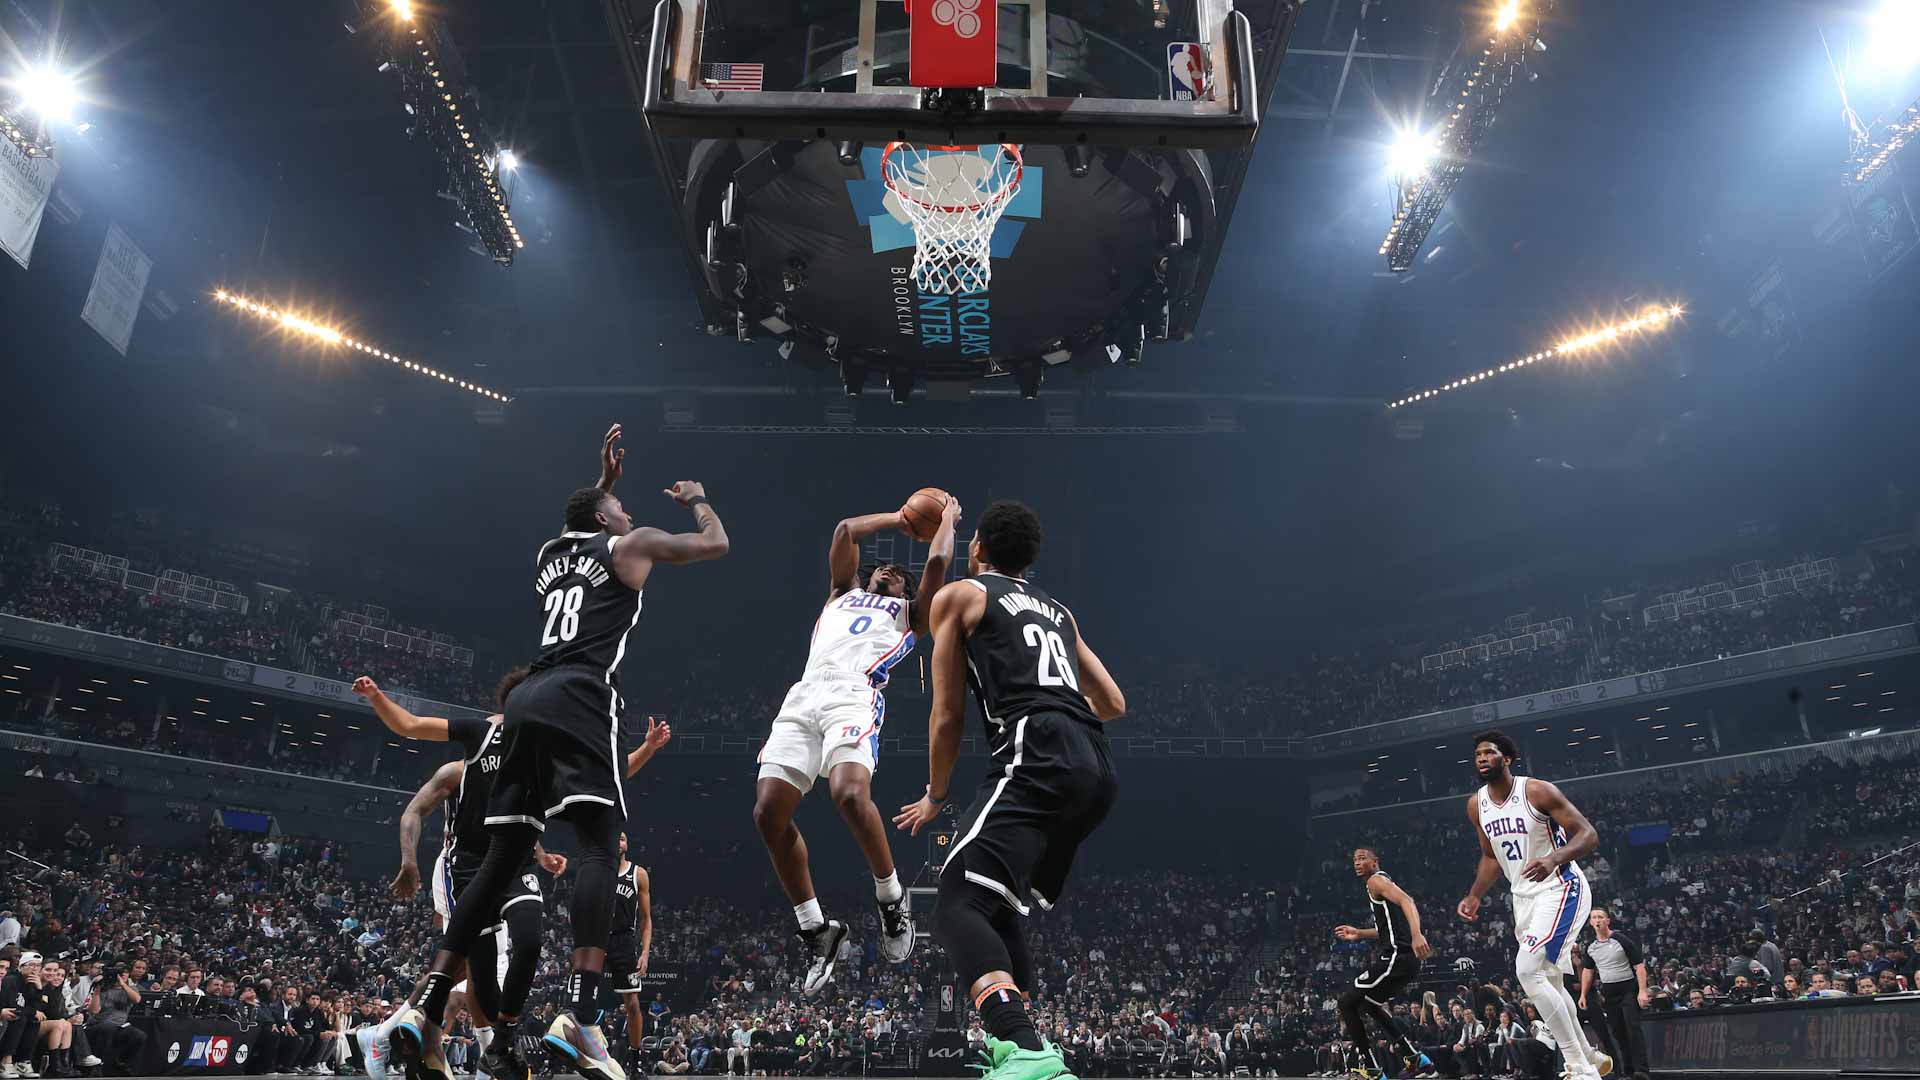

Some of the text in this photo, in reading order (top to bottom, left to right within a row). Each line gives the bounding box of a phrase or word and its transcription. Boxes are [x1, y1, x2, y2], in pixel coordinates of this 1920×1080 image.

[1176, 91, 1192, 100] NBA
[891, 267, 914, 335] BROOKLYN
[535, 556, 609, 595] FINNEY-SMITH
[542, 585, 584, 647] 28
[837, 594, 902, 621] PHILA
[849, 615, 873, 635] 0
[1022, 623, 1079, 692] 26
[842, 725, 861, 737] 76
[1484, 817, 1528, 841] PHILA
[1501, 839, 1523, 861] 21
[648, 972, 678, 980] SUNTORY
[1672, 1022, 1729, 1061] PLAYOFFS
[1820, 1012, 1900, 1059] PLAYOFFS
[928, 1048, 964, 1058] KIA
